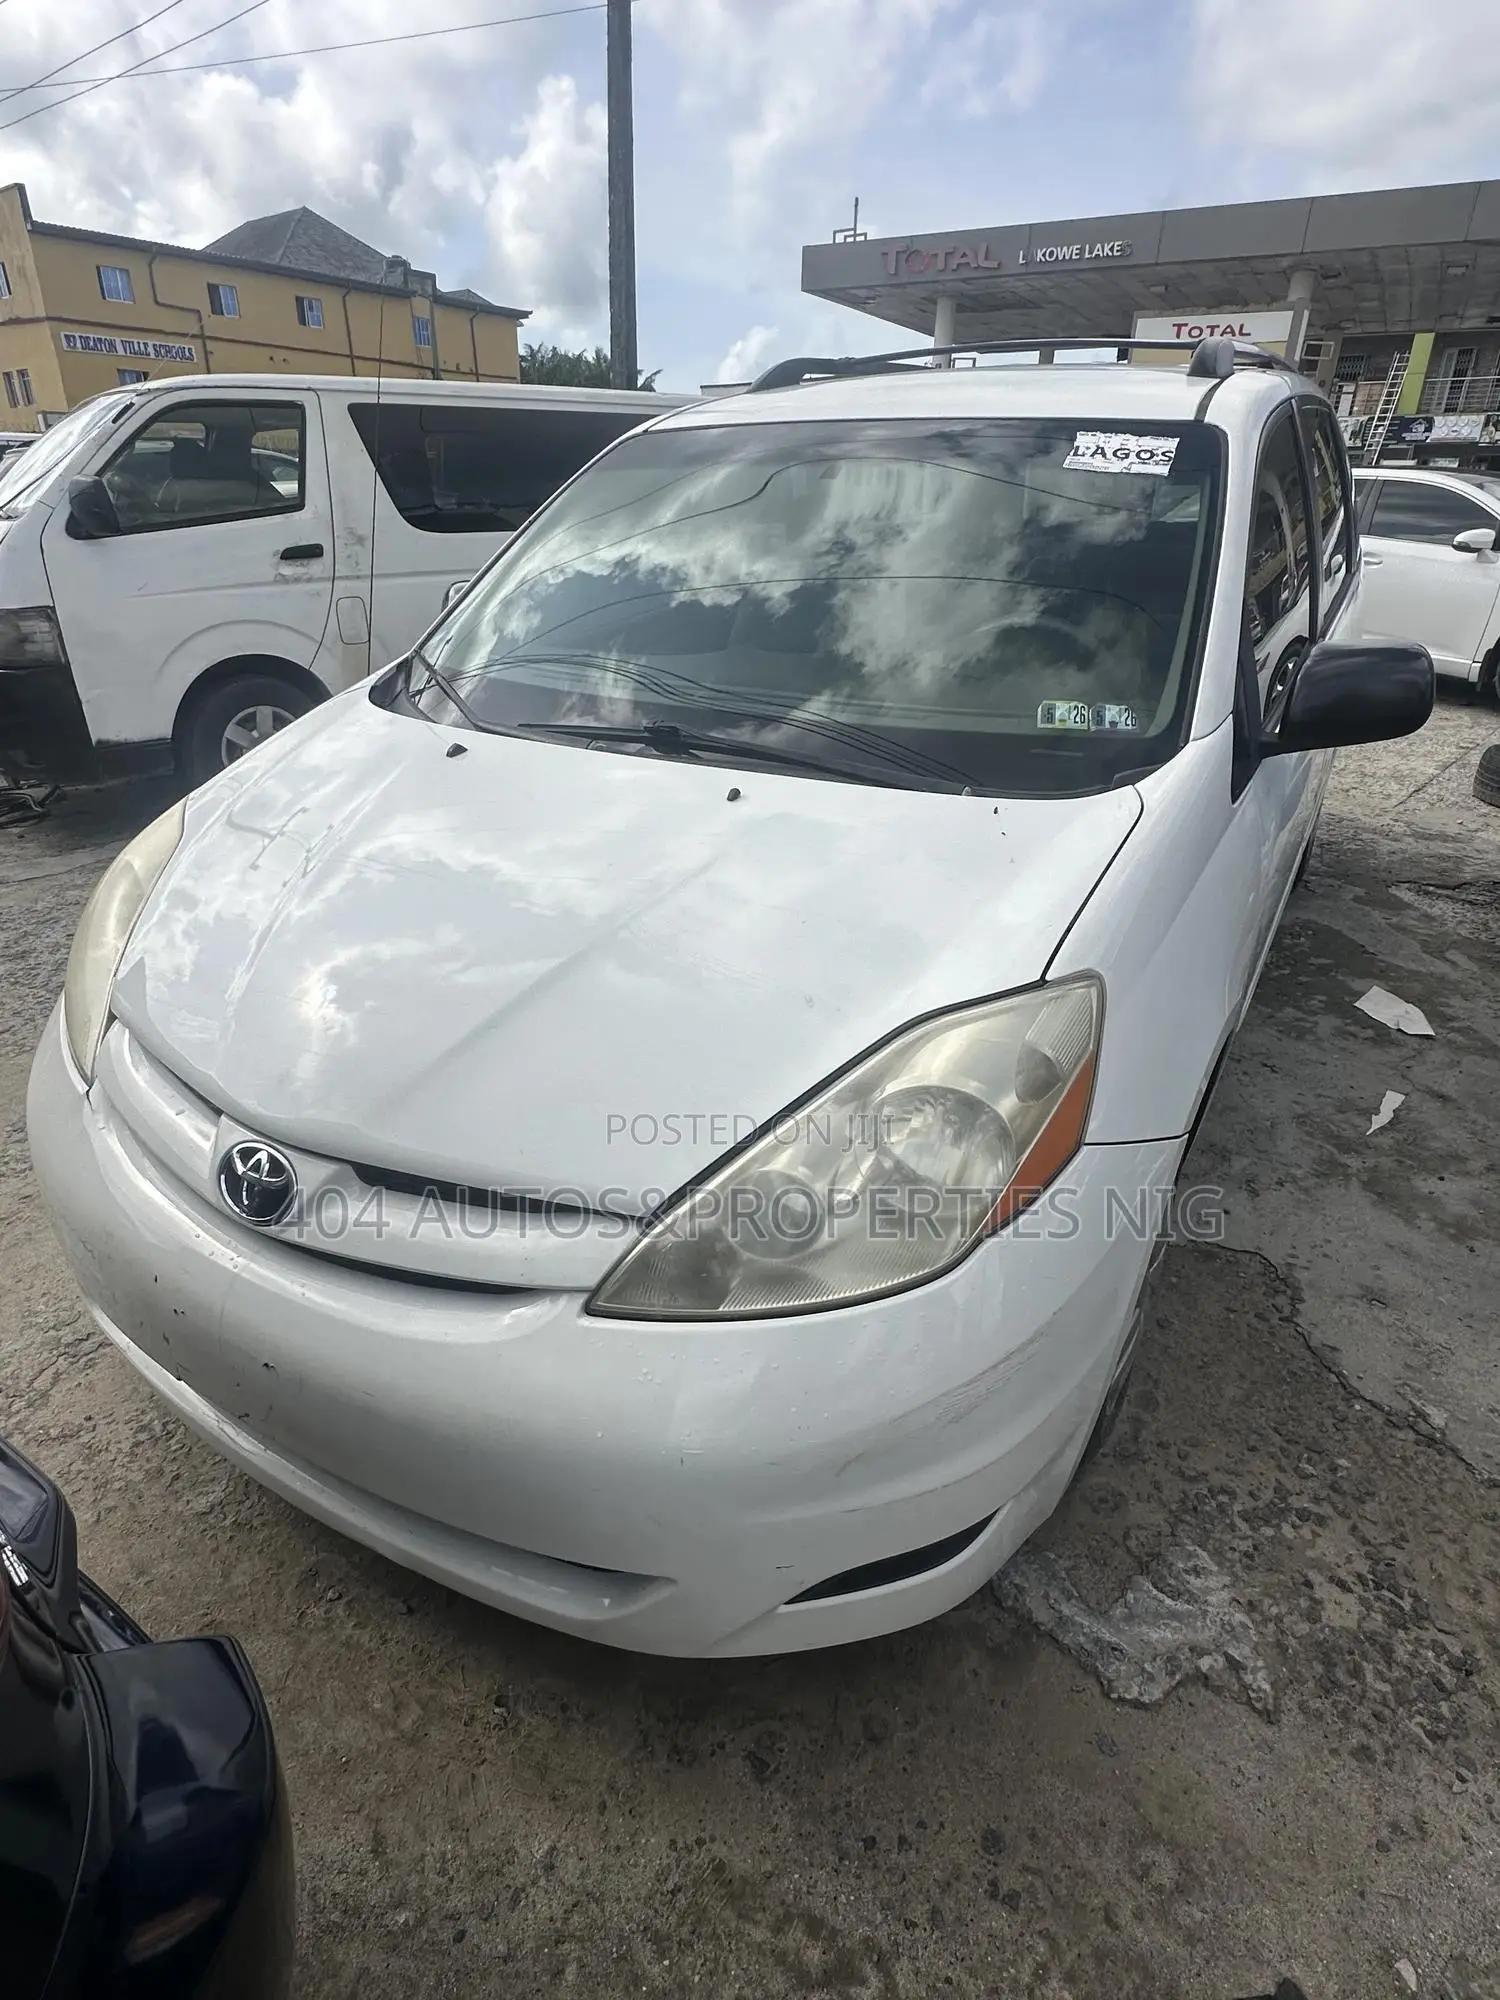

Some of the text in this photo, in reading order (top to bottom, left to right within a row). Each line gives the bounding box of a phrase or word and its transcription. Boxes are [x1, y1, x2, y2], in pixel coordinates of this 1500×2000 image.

[881, 243, 1001, 275] TOTAL
[1019, 244, 1081, 264] LKOWE
[1172, 323, 1251, 339] TOTAL
[79, 335, 195, 361] DEATON VILLE SCHOOLS
[1072, 445, 1174, 462] LAGOS
[1073, 705, 1086, 724] 26
[1124, 707, 1137, 727] 26
